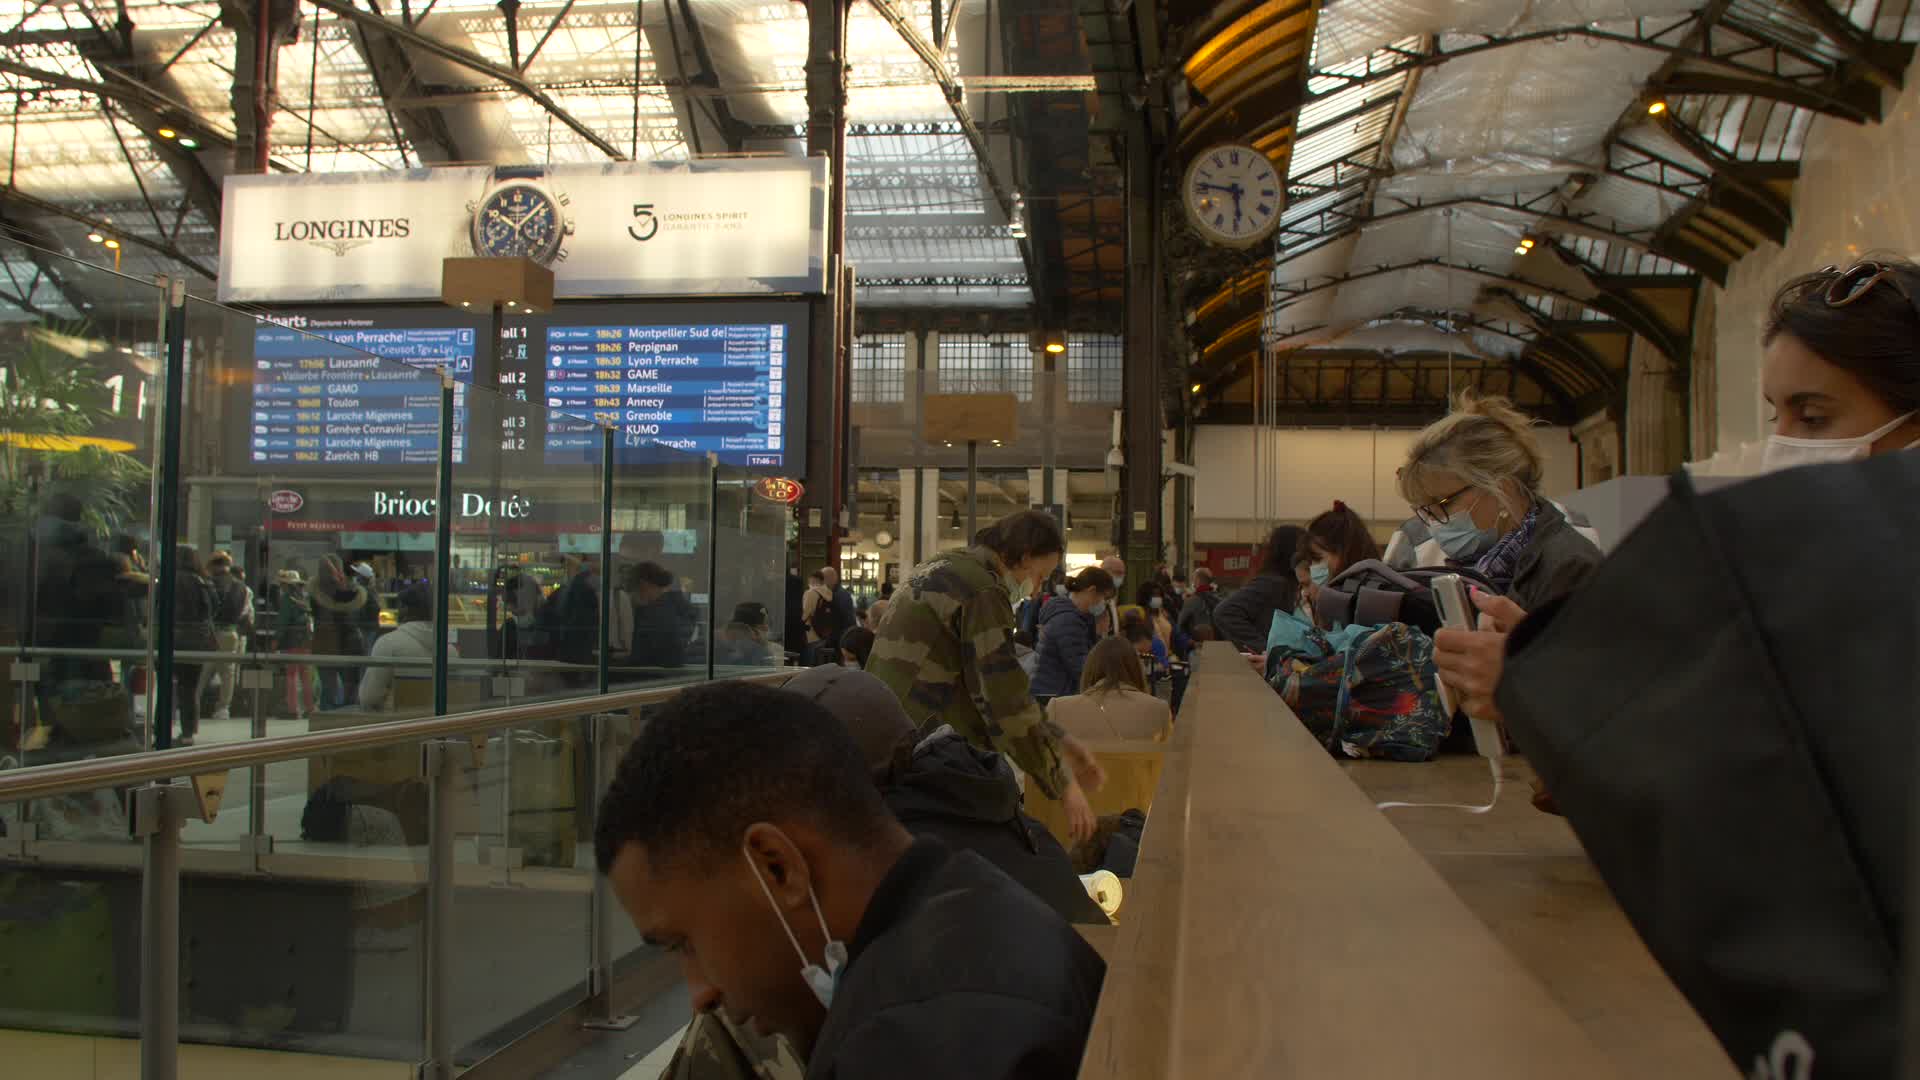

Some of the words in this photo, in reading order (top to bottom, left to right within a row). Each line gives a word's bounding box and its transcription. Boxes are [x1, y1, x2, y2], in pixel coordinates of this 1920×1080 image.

[627, 203, 659, 241] 5
[663, 213, 714, 222] LONGINES
[274, 218, 411, 241] LONGINES
[356, 331, 403, 343] Perrache
[628, 328, 688, 340] Montpellier
[689, 327, 709, 337] Sud
[628, 342, 678, 354] Perpignan
[628, 355, 654, 367] Lyon
[654, 355, 699, 366] Perrache
[518, 372, 526, 384] 2
[627, 369, 659, 380] GAME
[627, 383, 673, 393] Marseille
[327, 397, 360, 408] Toulon
[626, 397, 664, 409] Annecy
[626, 410, 673, 421] Grenoble
[518, 416, 526, 428] 3
[626, 424, 660, 435] KUMO
[518, 439, 525, 450] 2
